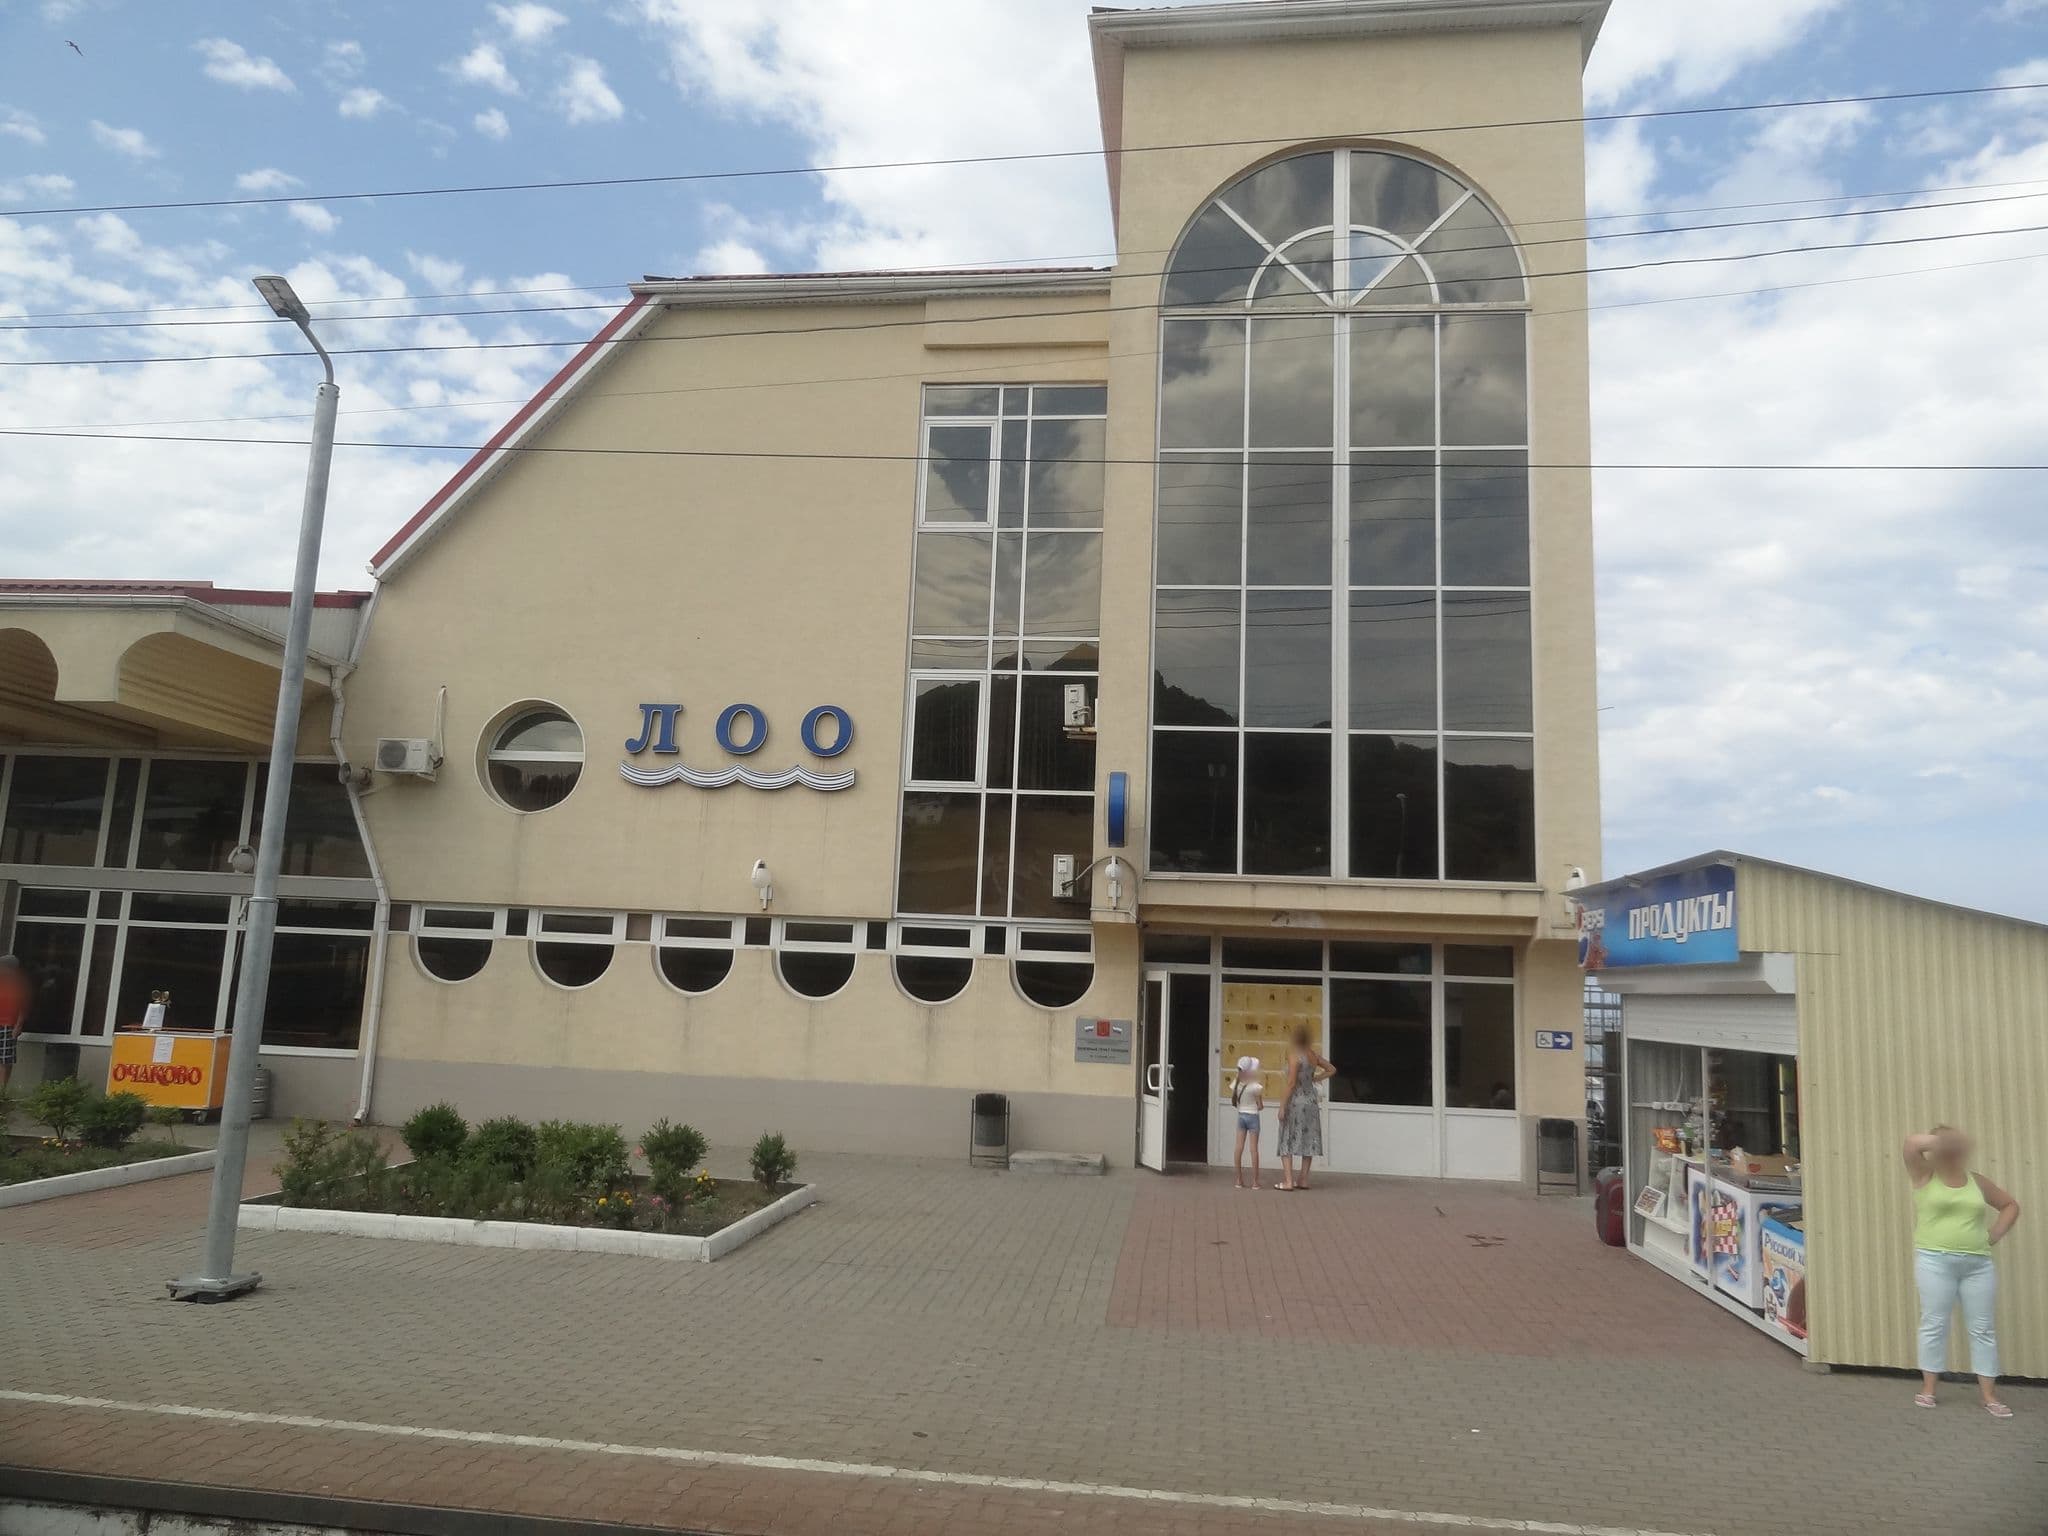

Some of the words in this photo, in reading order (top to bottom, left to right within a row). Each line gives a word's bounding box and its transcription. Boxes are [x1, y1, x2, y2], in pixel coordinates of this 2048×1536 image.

[624, 702, 855, 757] ЛОО
[1628, 890, 1735, 944] ПРОДУКТЫ
[112, 1063, 202, 1086] ОЧАКОВО
